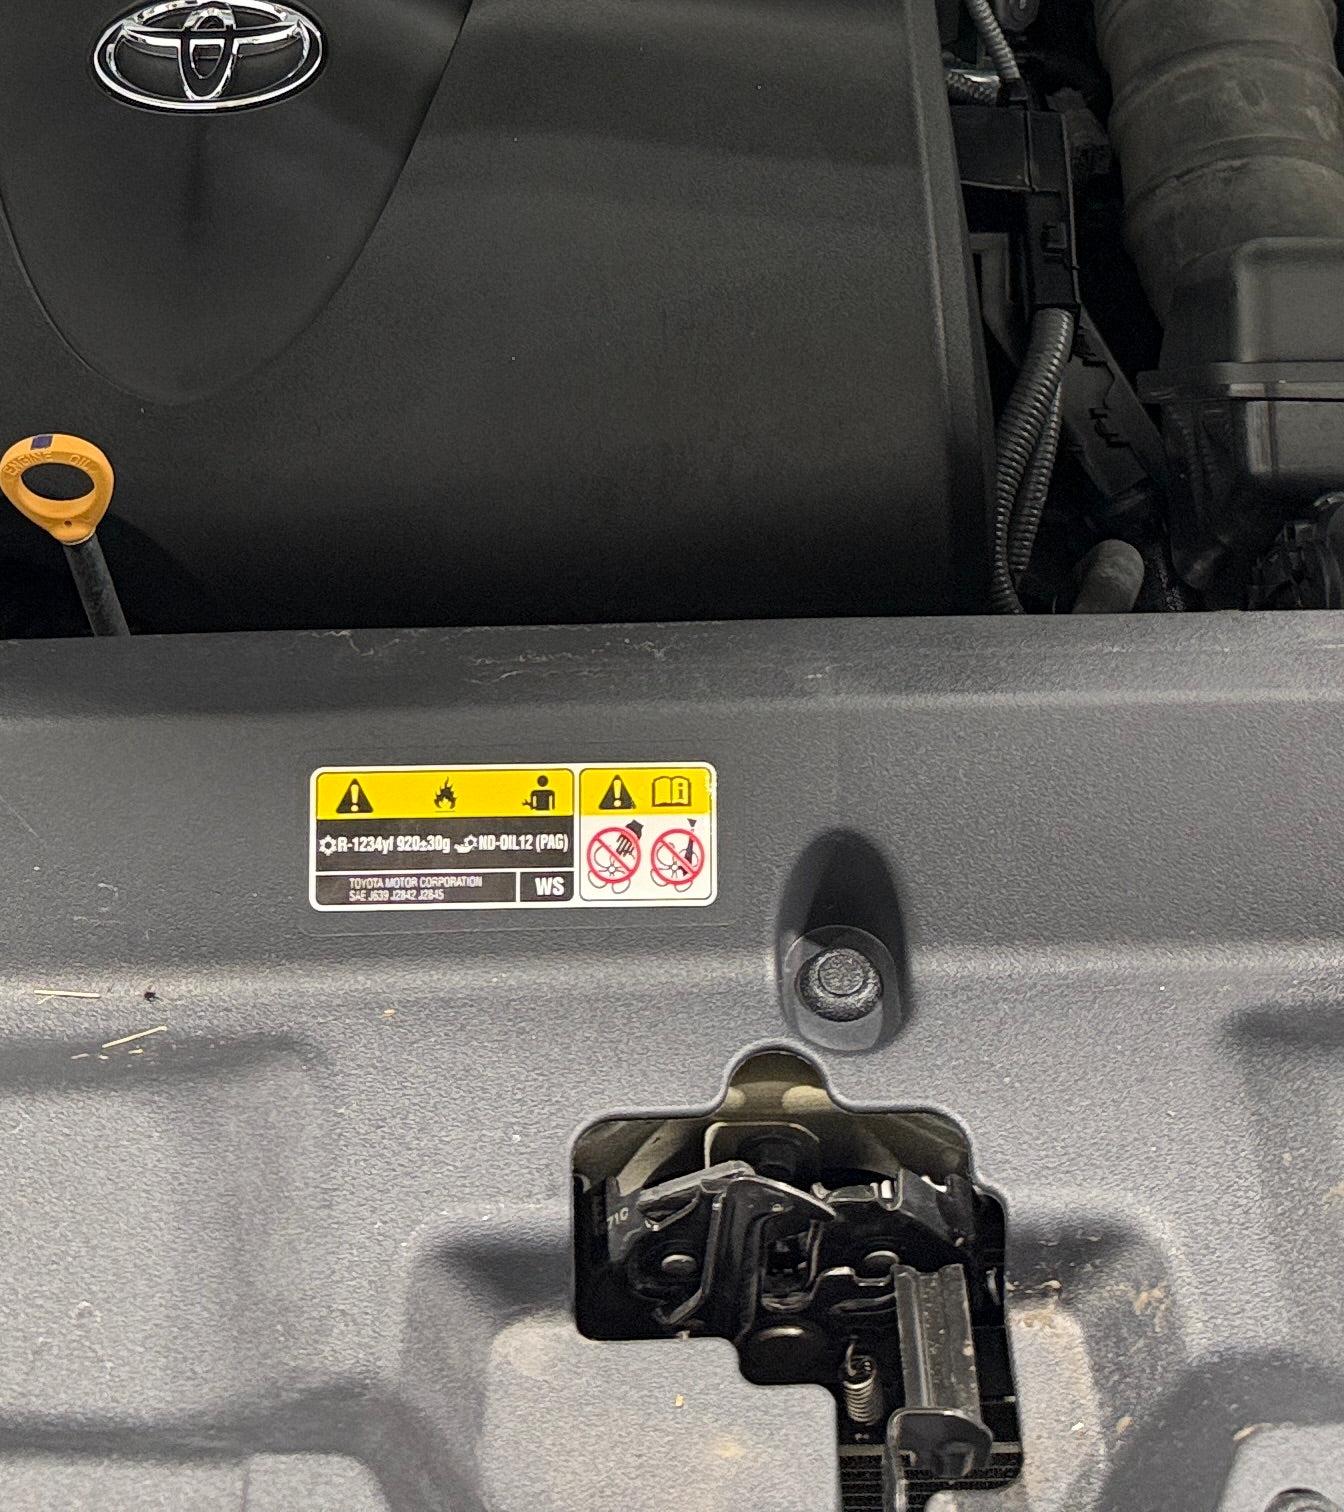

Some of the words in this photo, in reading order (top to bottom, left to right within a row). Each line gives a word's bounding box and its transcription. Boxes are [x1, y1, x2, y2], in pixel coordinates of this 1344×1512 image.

[2, 451, 54, 476] ENGINE
[337, 835, 395, 855] R-1234yf
[535, 833, 569, 853] (PAG)
[349, 877, 384, 890] TOYOTA
[384, 876, 419, 889] MOTOR
[419, 875, 483, 889] CORPORATION
[534, 876, 566, 897] WS
[348, 889, 367, 902] SAE
